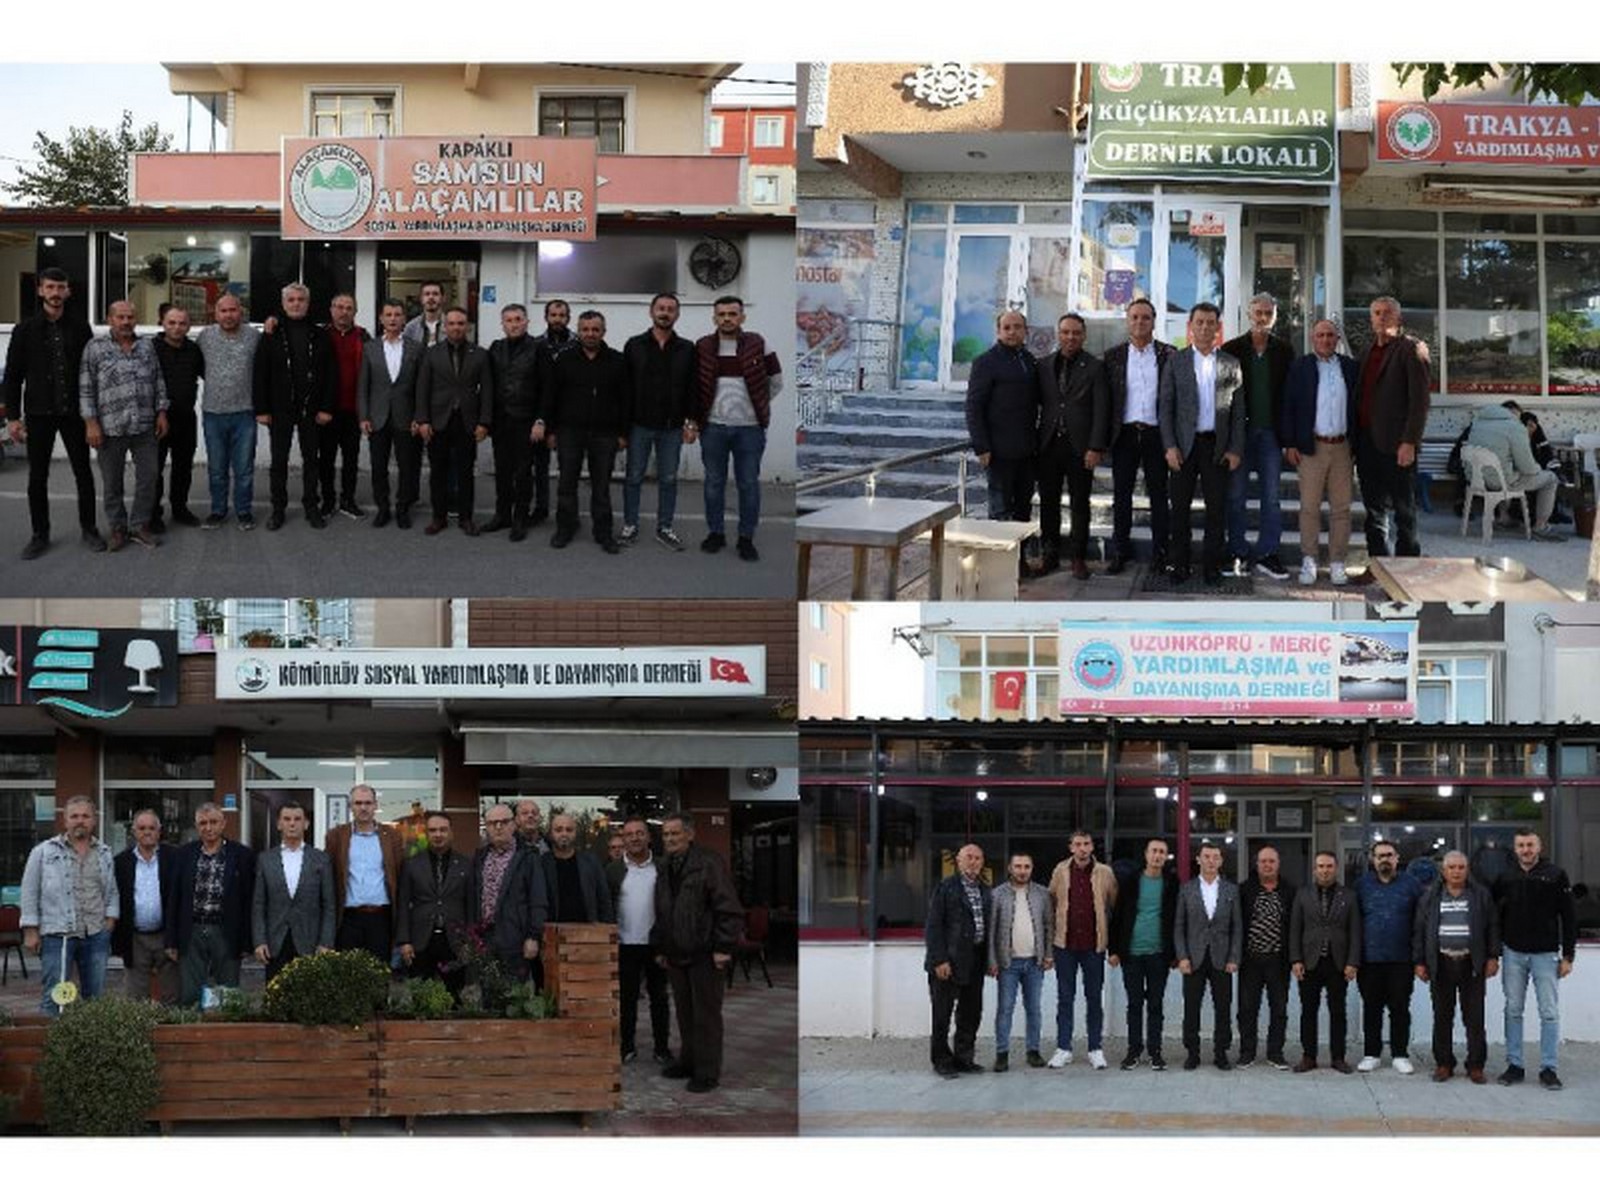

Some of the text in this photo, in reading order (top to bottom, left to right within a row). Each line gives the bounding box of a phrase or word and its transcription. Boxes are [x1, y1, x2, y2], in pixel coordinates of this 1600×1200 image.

[1160, 63, 1296, 90] TRAA
[1098, 99, 1328, 127] KÜÇÜKYAYLALILAR
[1463, 114, 1575, 137] TRAKYA
[438, 142, 513, 159] KAPAKLI
[1104, 142, 1318, 167] DERNEK LOKALİ
[1452, 141, 1583, 161] YARDIMLAŞMA
[412, 160, 544, 185] SAMSUN
[375, 188, 585, 218] ALAÇAMLILAR
[364, 220, 400, 232] SOSYA
[1130, 631, 1253, 652] UZUNKÖPRÜ
[1270, 633, 1332, 657] MERİÇ
[364, 663, 417, 686] SOSYAL
[421, 663, 529, 688] YARDIMLAŞMA
[533, 663, 551, 685] VE
[555, 663, 638, 688] DAYANIŞMA
[643, 659, 702, 684] DERNEĞİ
[1132, 655, 1331, 679] YARDIMLAŞMA ve
[1132, 677, 1332, 700] DAYANIŞMA DERNEĞİ
